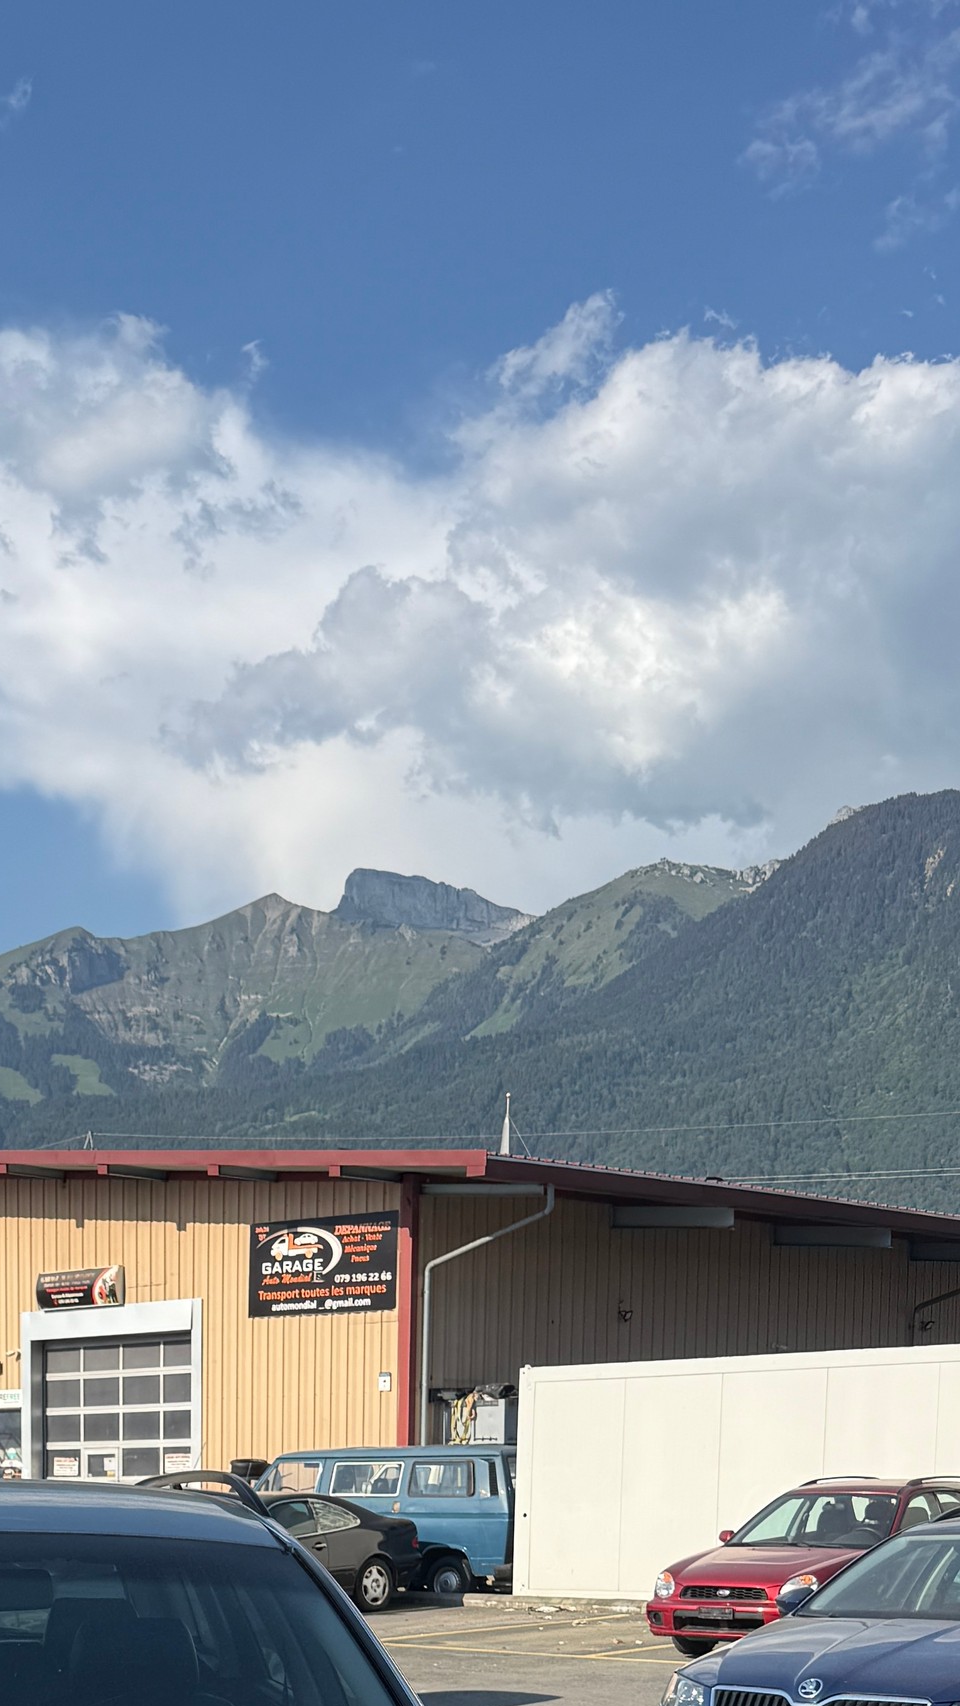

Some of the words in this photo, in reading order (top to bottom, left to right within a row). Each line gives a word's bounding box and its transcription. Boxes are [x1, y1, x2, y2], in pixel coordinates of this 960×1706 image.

[262, 1258, 324, 1274] GARAGE
[334, 1273, 351, 1283] 079
[351, 1272, 368, 1282] 196
[368, 1272, 379, 1281] 22
[258, 1289, 300, 1301] Transport
[301, 1287, 330, 1299] toutes
[331, 1285, 344, 1296] les
[346, 1284, 387, 1296] marques
